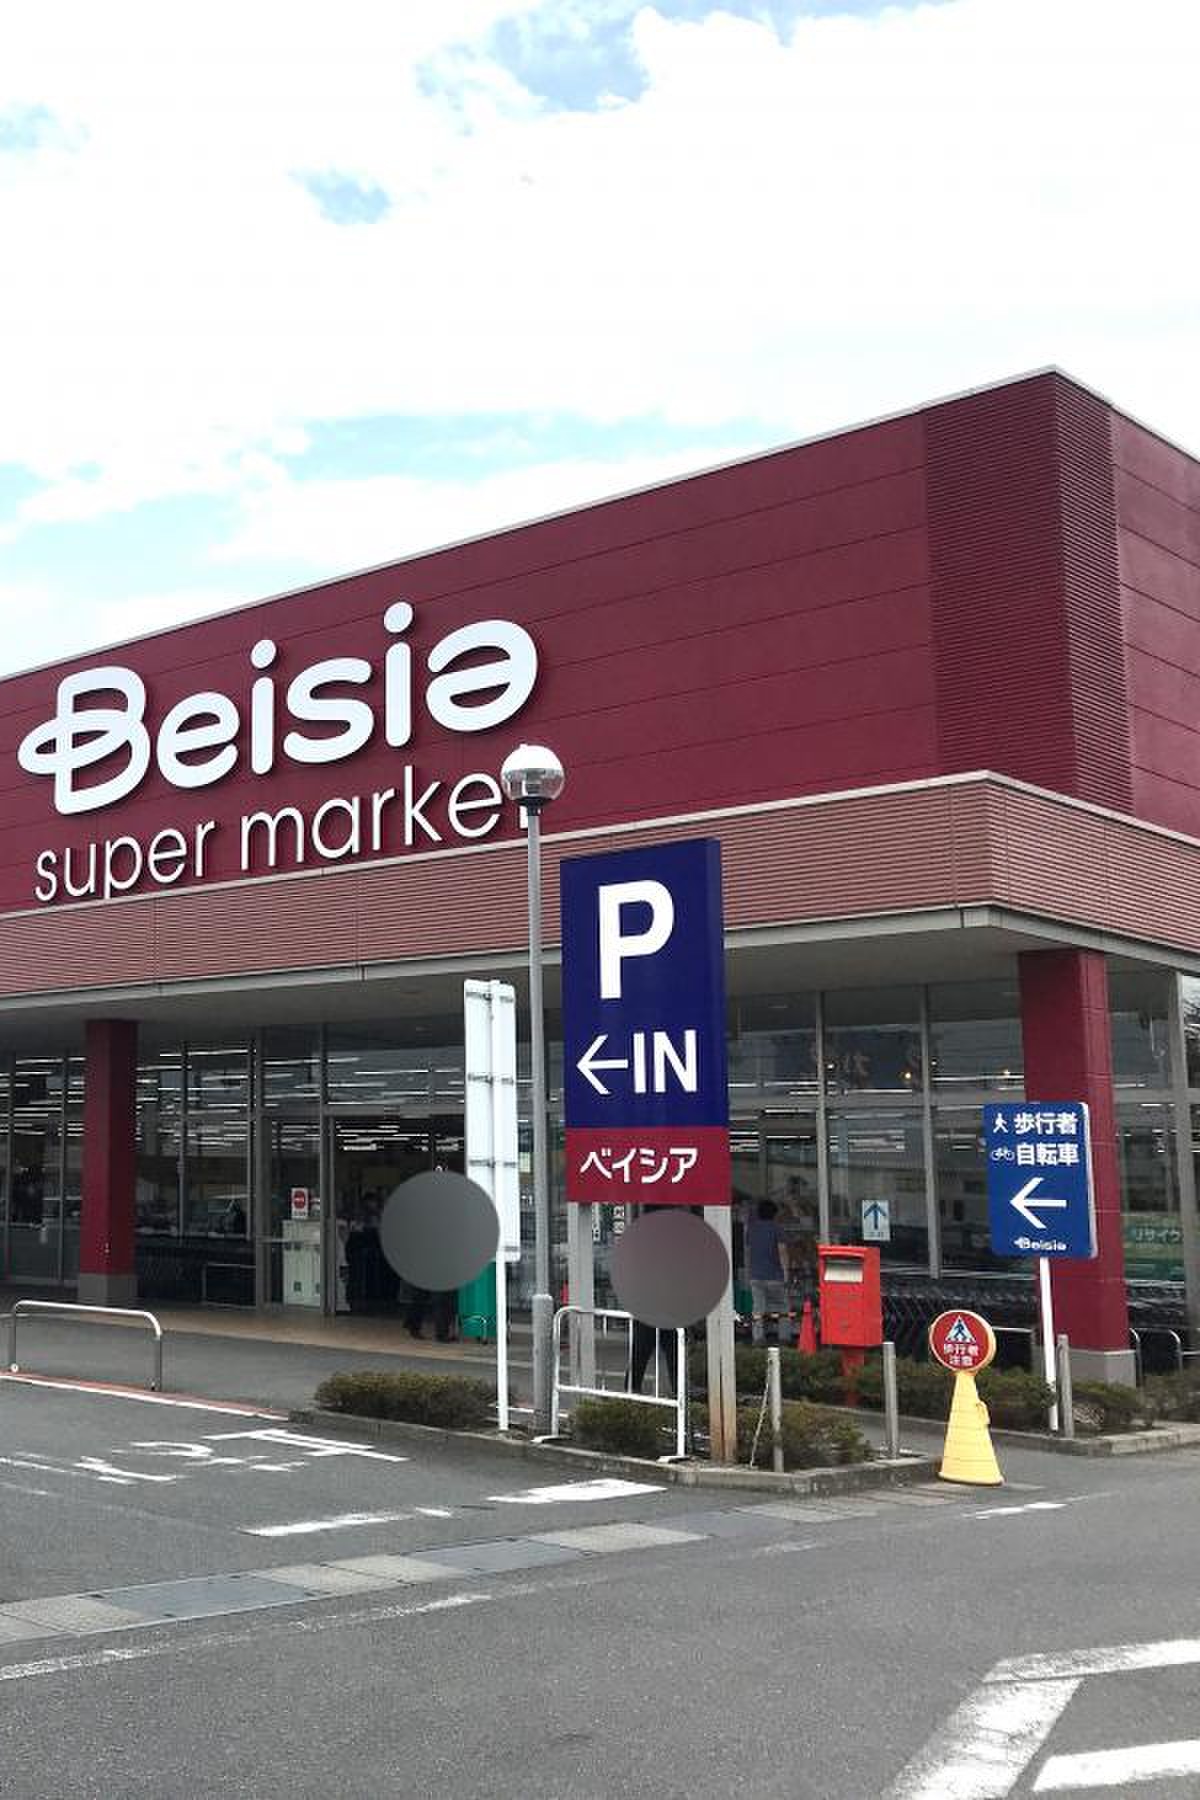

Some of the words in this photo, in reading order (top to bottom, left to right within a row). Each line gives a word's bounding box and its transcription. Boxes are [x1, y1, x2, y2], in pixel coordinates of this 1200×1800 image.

[17, 601, 539, 815] Beisia
[34, 818, 216, 902] super
[240, 765, 531, 871] marke
[598, 879, 675, 1000] P
[632, 1029, 698, 1094] IN
[1013, 1111, 1079, 1135] 歩行者
[1016, 1142, 1080, 1166] 自転車
[579, 1147, 698, 1184] ベイシア
